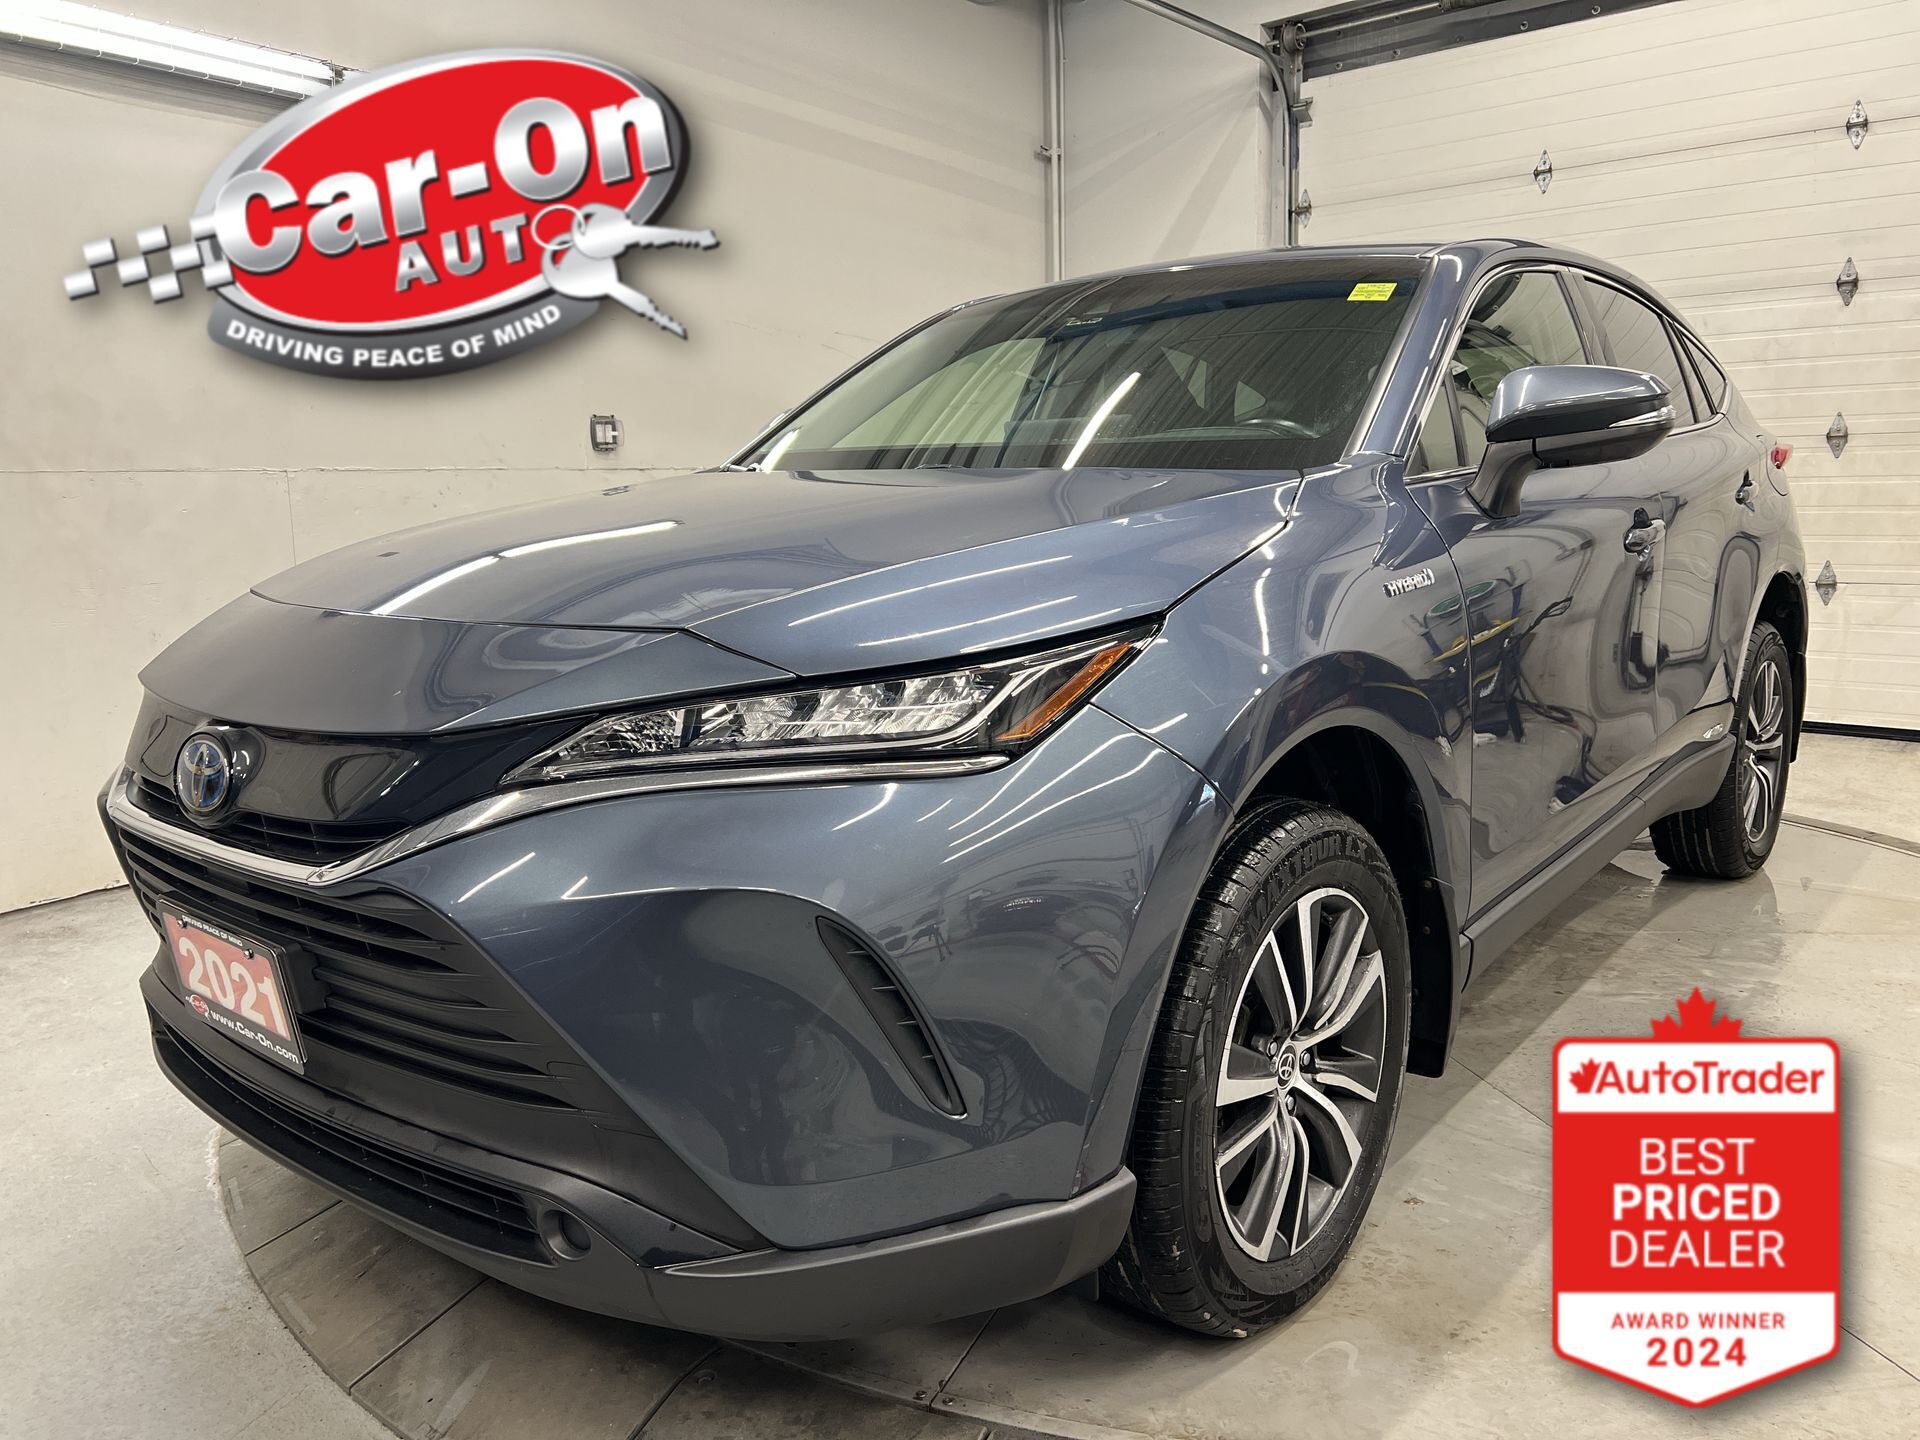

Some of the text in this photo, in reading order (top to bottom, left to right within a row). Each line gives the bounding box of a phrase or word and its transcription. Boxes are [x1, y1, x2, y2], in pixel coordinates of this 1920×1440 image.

[1387, 572, 1428, 596] HYBRID
[178, 936, 288, 1038] 2021
[210, 1010, 300, 1065] www.Car-On.com
